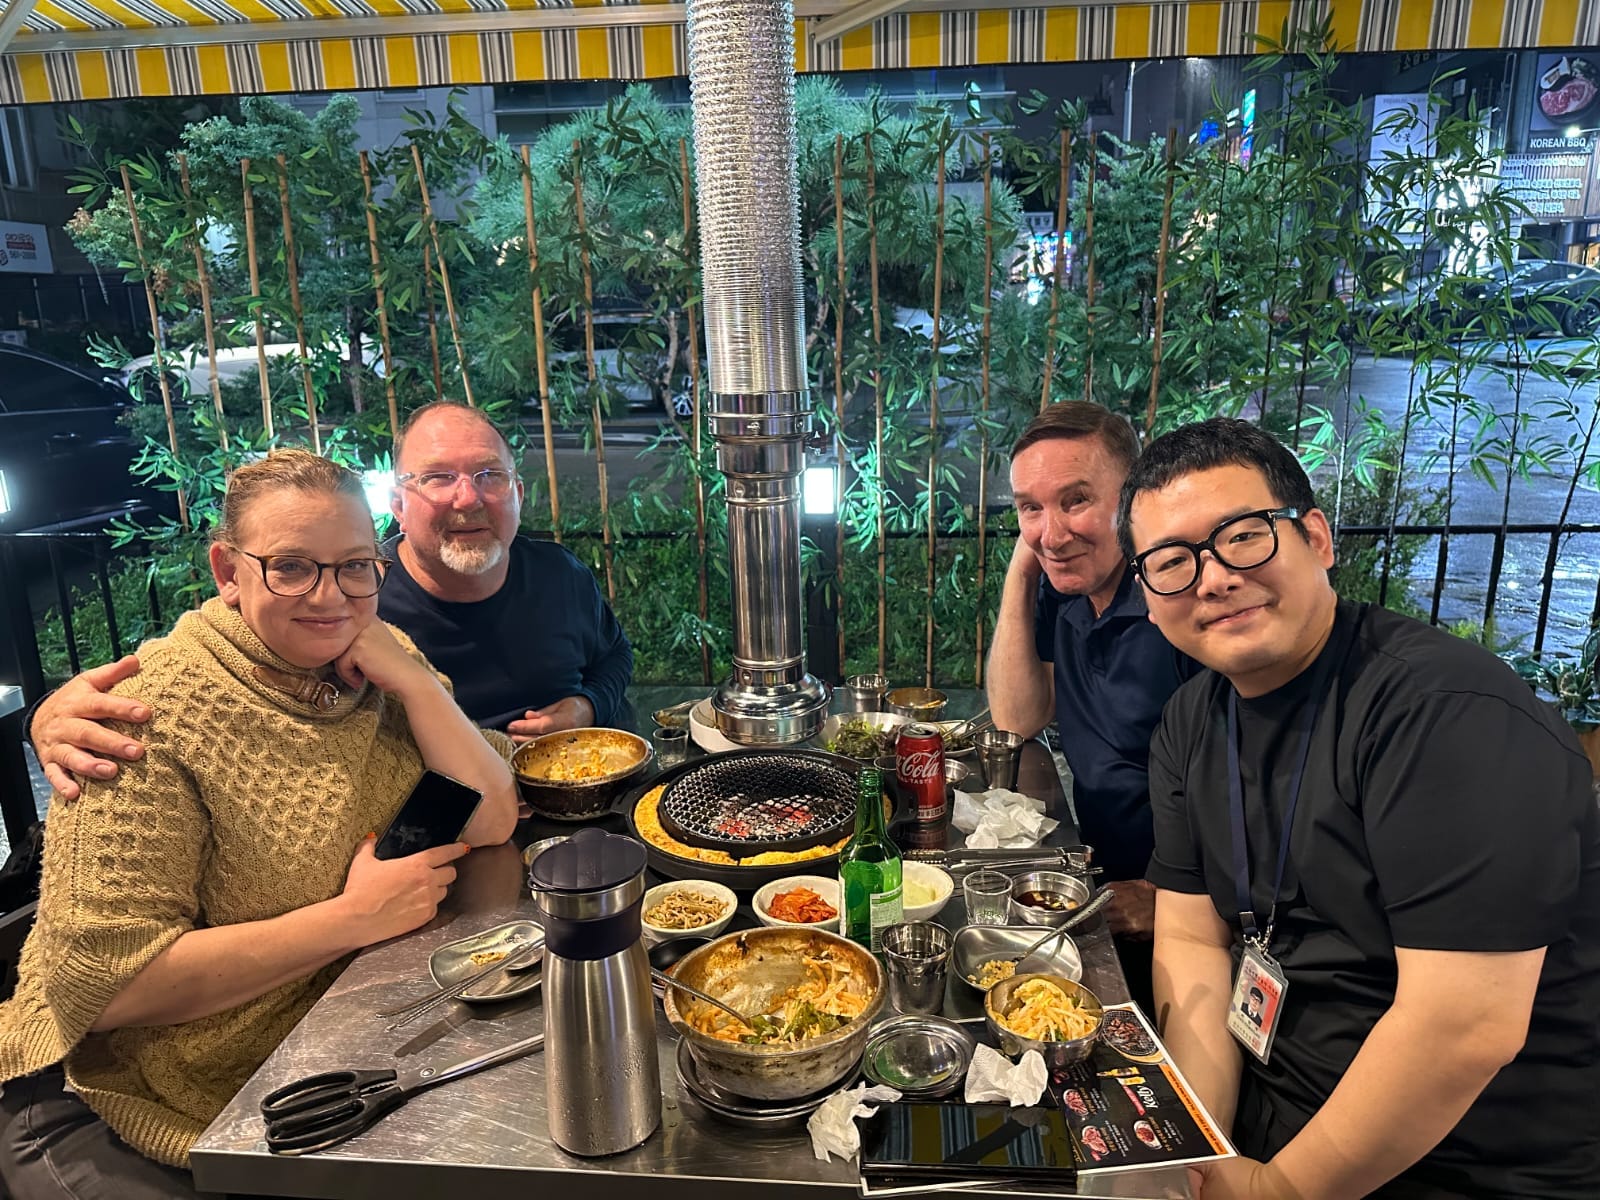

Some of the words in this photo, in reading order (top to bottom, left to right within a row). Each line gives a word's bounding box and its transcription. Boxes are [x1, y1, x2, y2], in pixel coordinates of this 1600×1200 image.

[1530, 138, 1565, 148] KOREAN
[1567, 138, 1586, 148] BBQ
[1136, 1085, 1159, 1108] Kelly
